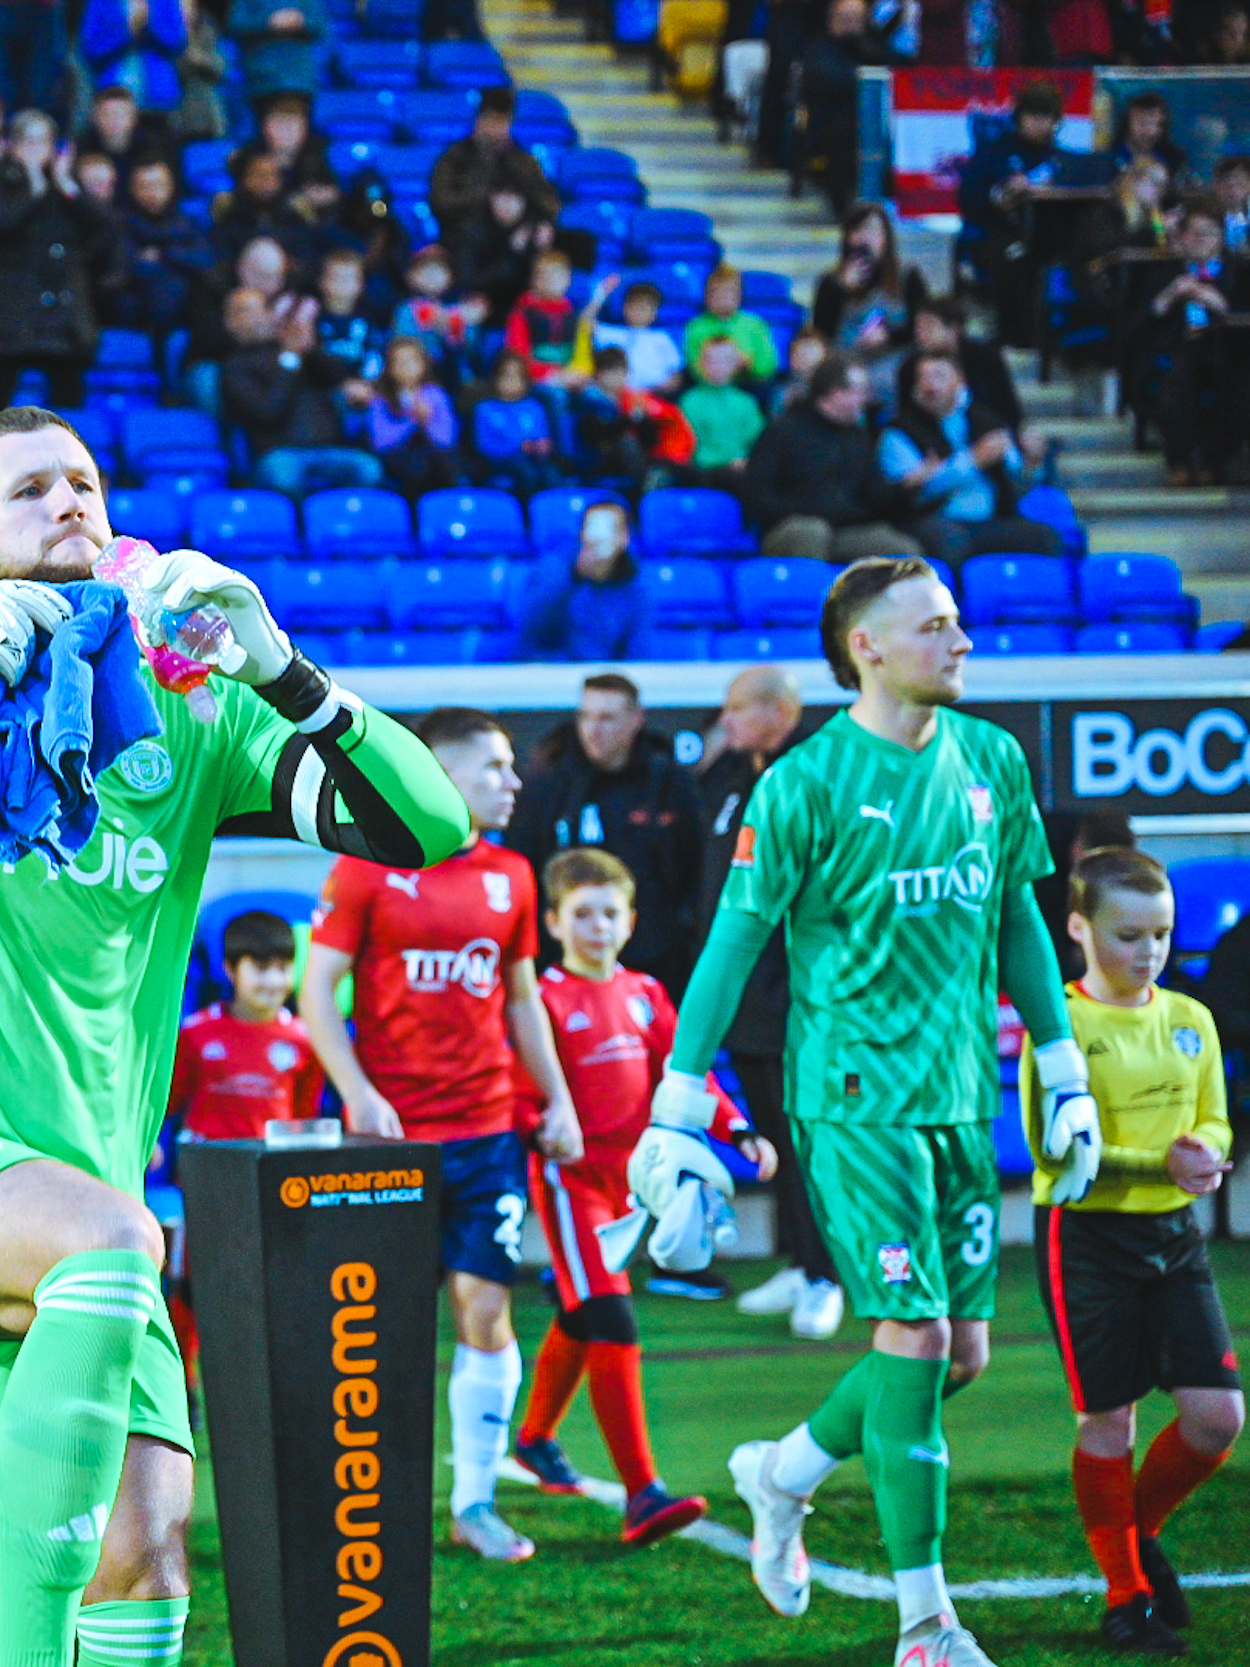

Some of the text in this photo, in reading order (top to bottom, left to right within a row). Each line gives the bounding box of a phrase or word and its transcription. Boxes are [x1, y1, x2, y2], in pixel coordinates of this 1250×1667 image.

[1072, 707, 1250, 797] BoC
[3, 817, 169, 893] uie
[888, 855, 990, 906] TITAN
[400, 943, 498, 990] TITAN
[310, 1168, 424, 1192] vanarama
[374, 1187, 424, 1204] LEAGUE
[961, 1202, 994, 1266] 3
[330, 1261, 384, 1628] vanarama
